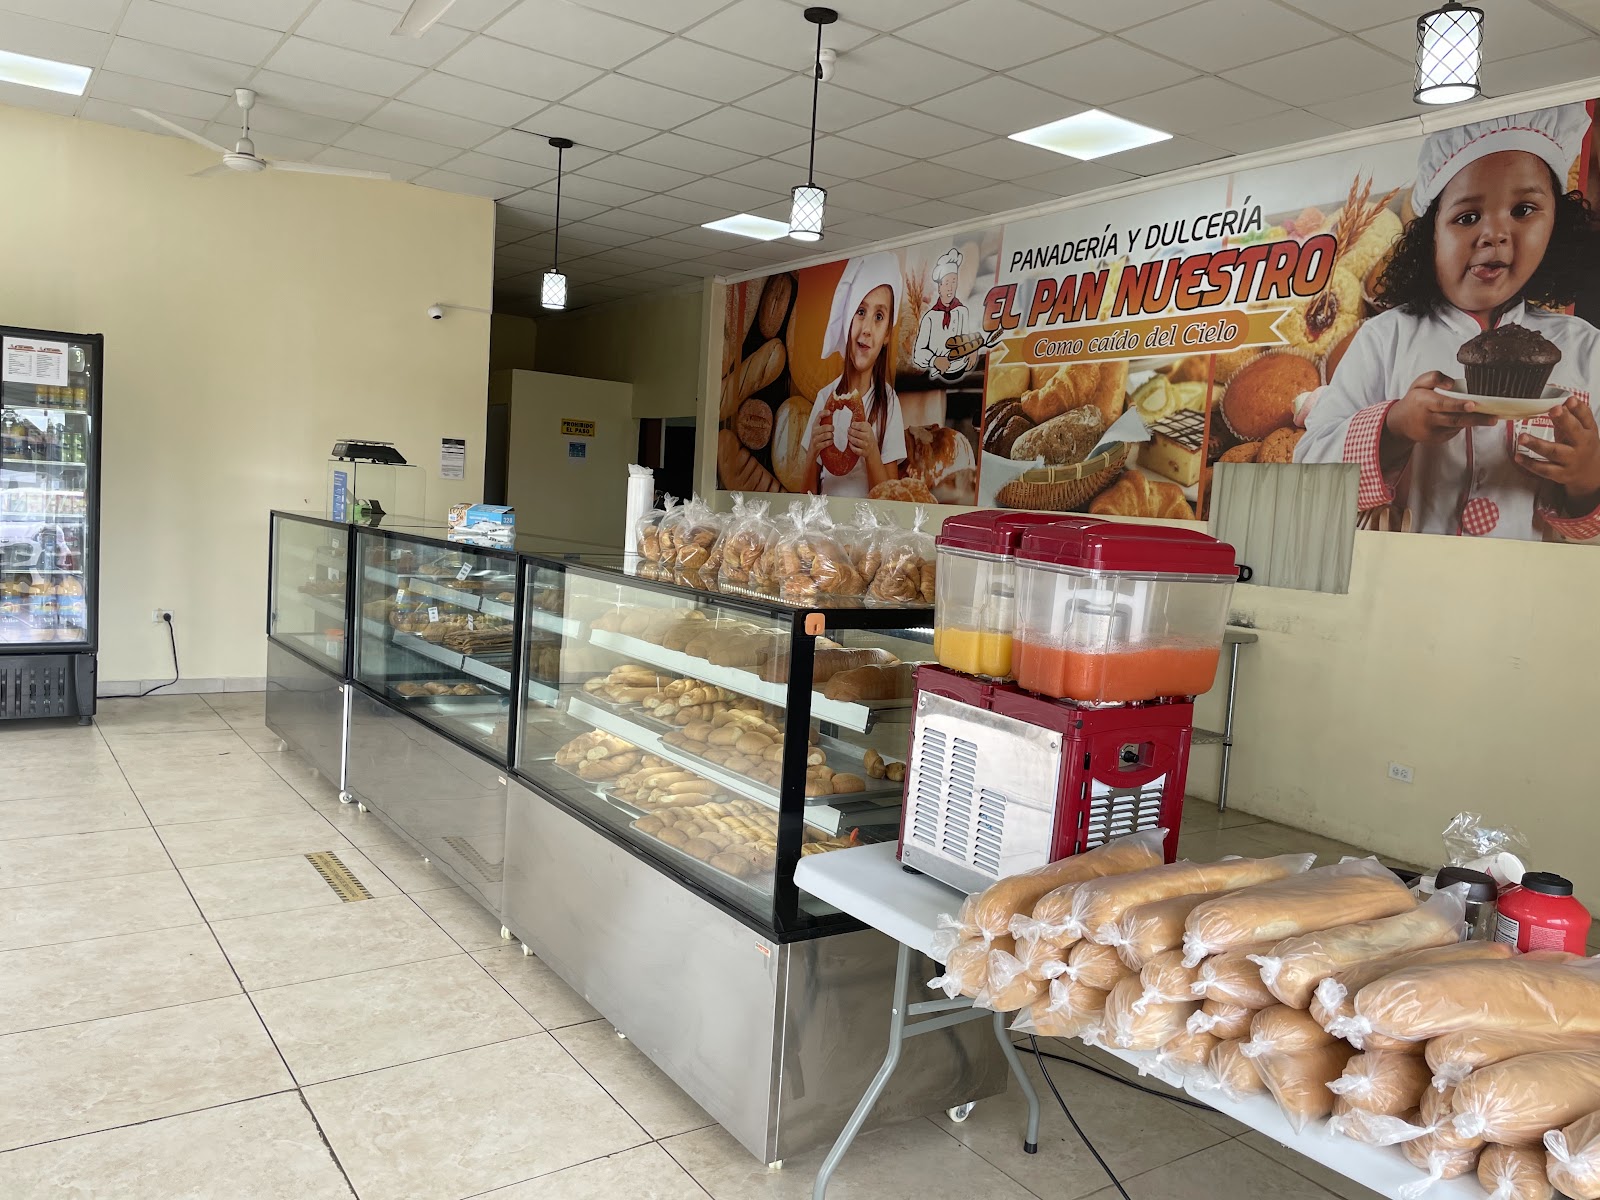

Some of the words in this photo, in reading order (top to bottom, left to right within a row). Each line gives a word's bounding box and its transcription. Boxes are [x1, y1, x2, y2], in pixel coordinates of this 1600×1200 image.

[1010, 225, 1119, 273] PANADERÍA
[1126, 227, 1143, 254] Y
[1145, 195, 1263, 249] DULCERÍA
[983, 283, 1021, 331] EL
[1027, 268, 1110, 326] PAN
[1112, 233, 1338, 317] NUESTRO
[1033, 332, 1083, 358] Como
[1087, 325, 1140, 353] caído
[1145, 325, 1176, 347] del
[1182, 321, 1237, 345] Cielo
